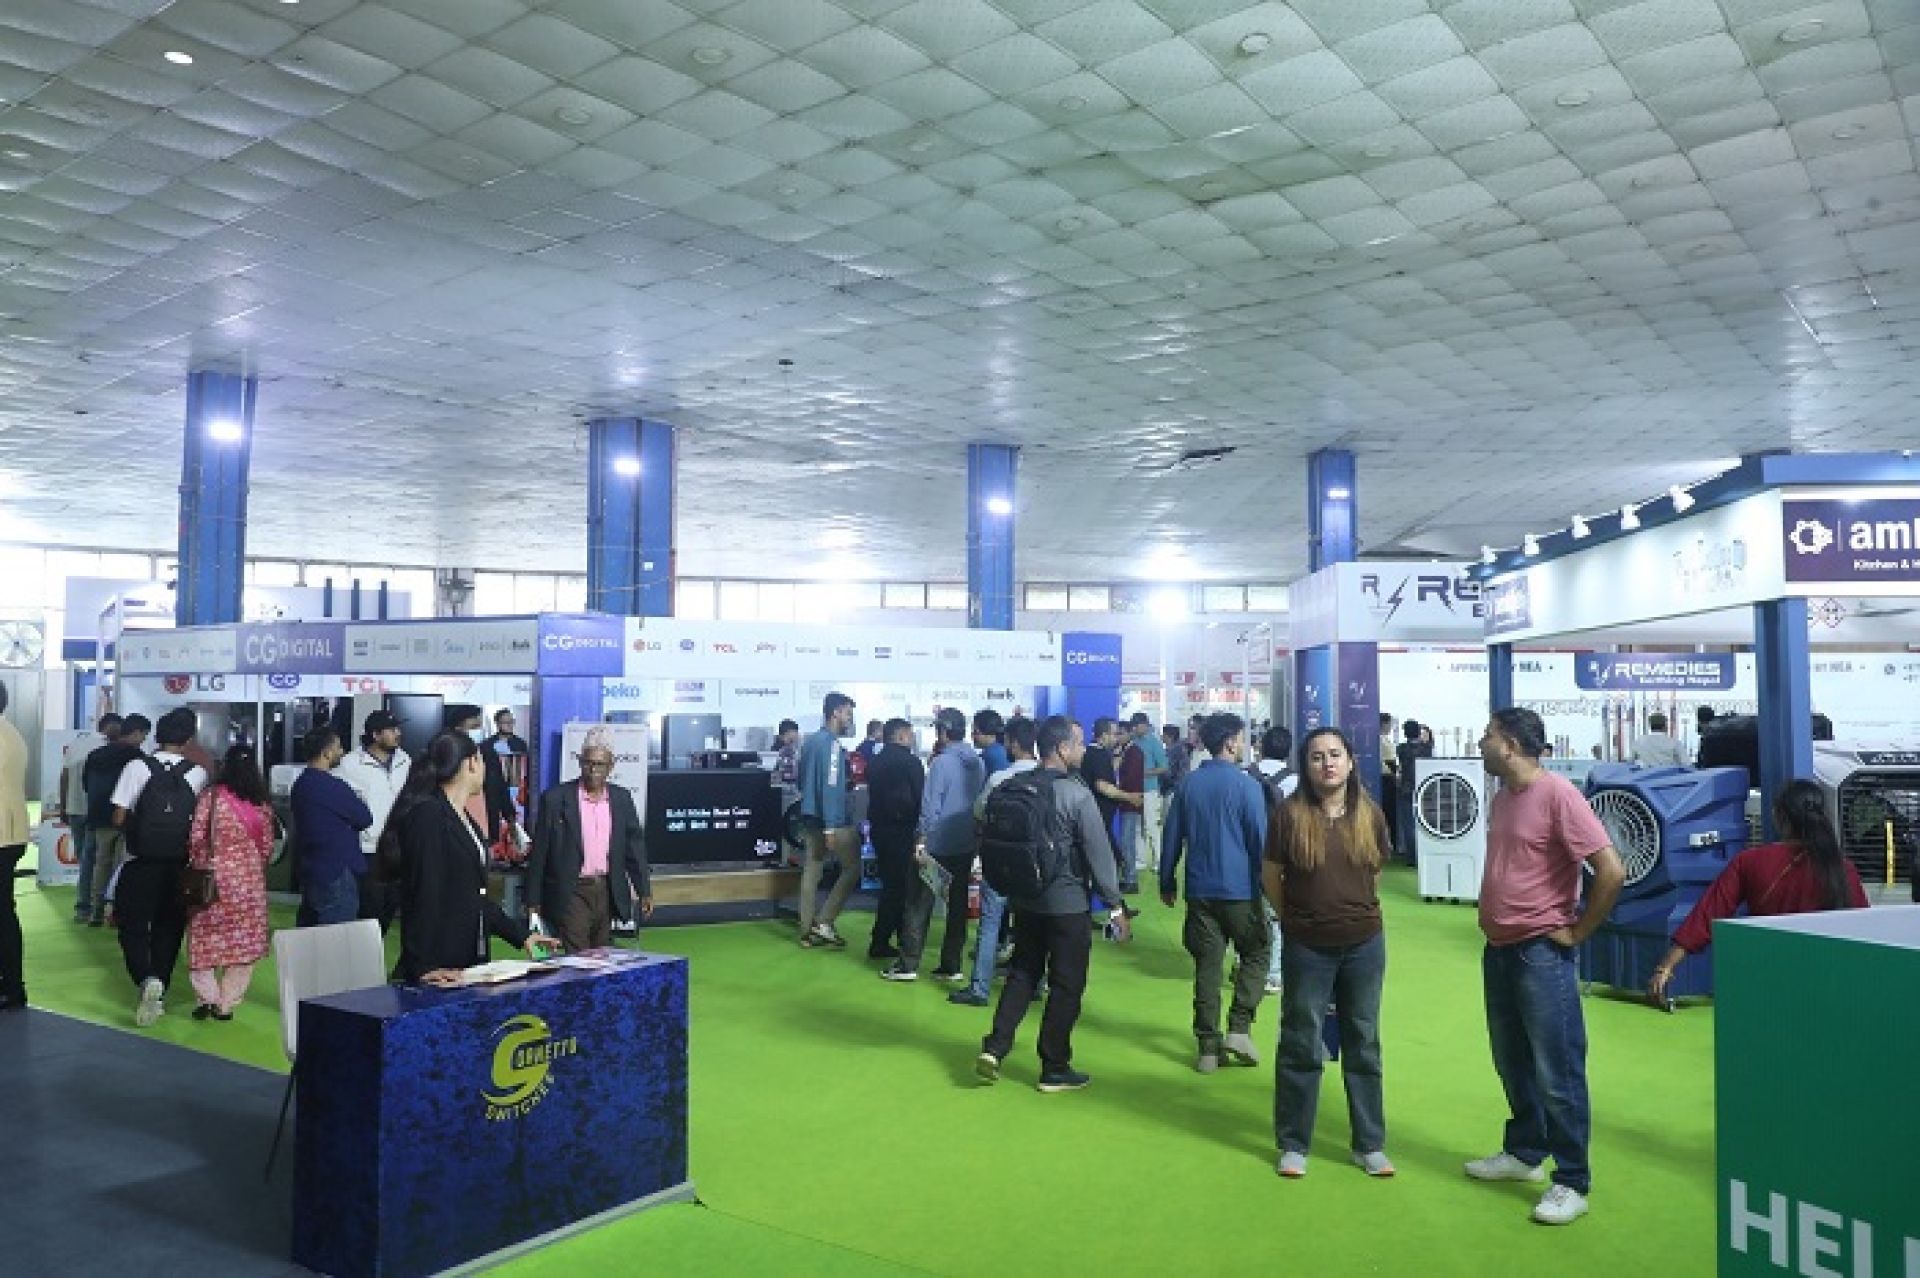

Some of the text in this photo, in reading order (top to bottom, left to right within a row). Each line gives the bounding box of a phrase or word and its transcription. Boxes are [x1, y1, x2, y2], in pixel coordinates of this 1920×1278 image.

[246, 633, 275, 665] CG
[277, 638, 334, 658] DIGITAL
[544, 633, 574, 651] CG
[1449, 662, 1488, 673] APPROV
[1614, 660, 1721, 679] REMEDIES
[196, 674, 226, 692] LG
[341, 677, 390, 694] TCL
